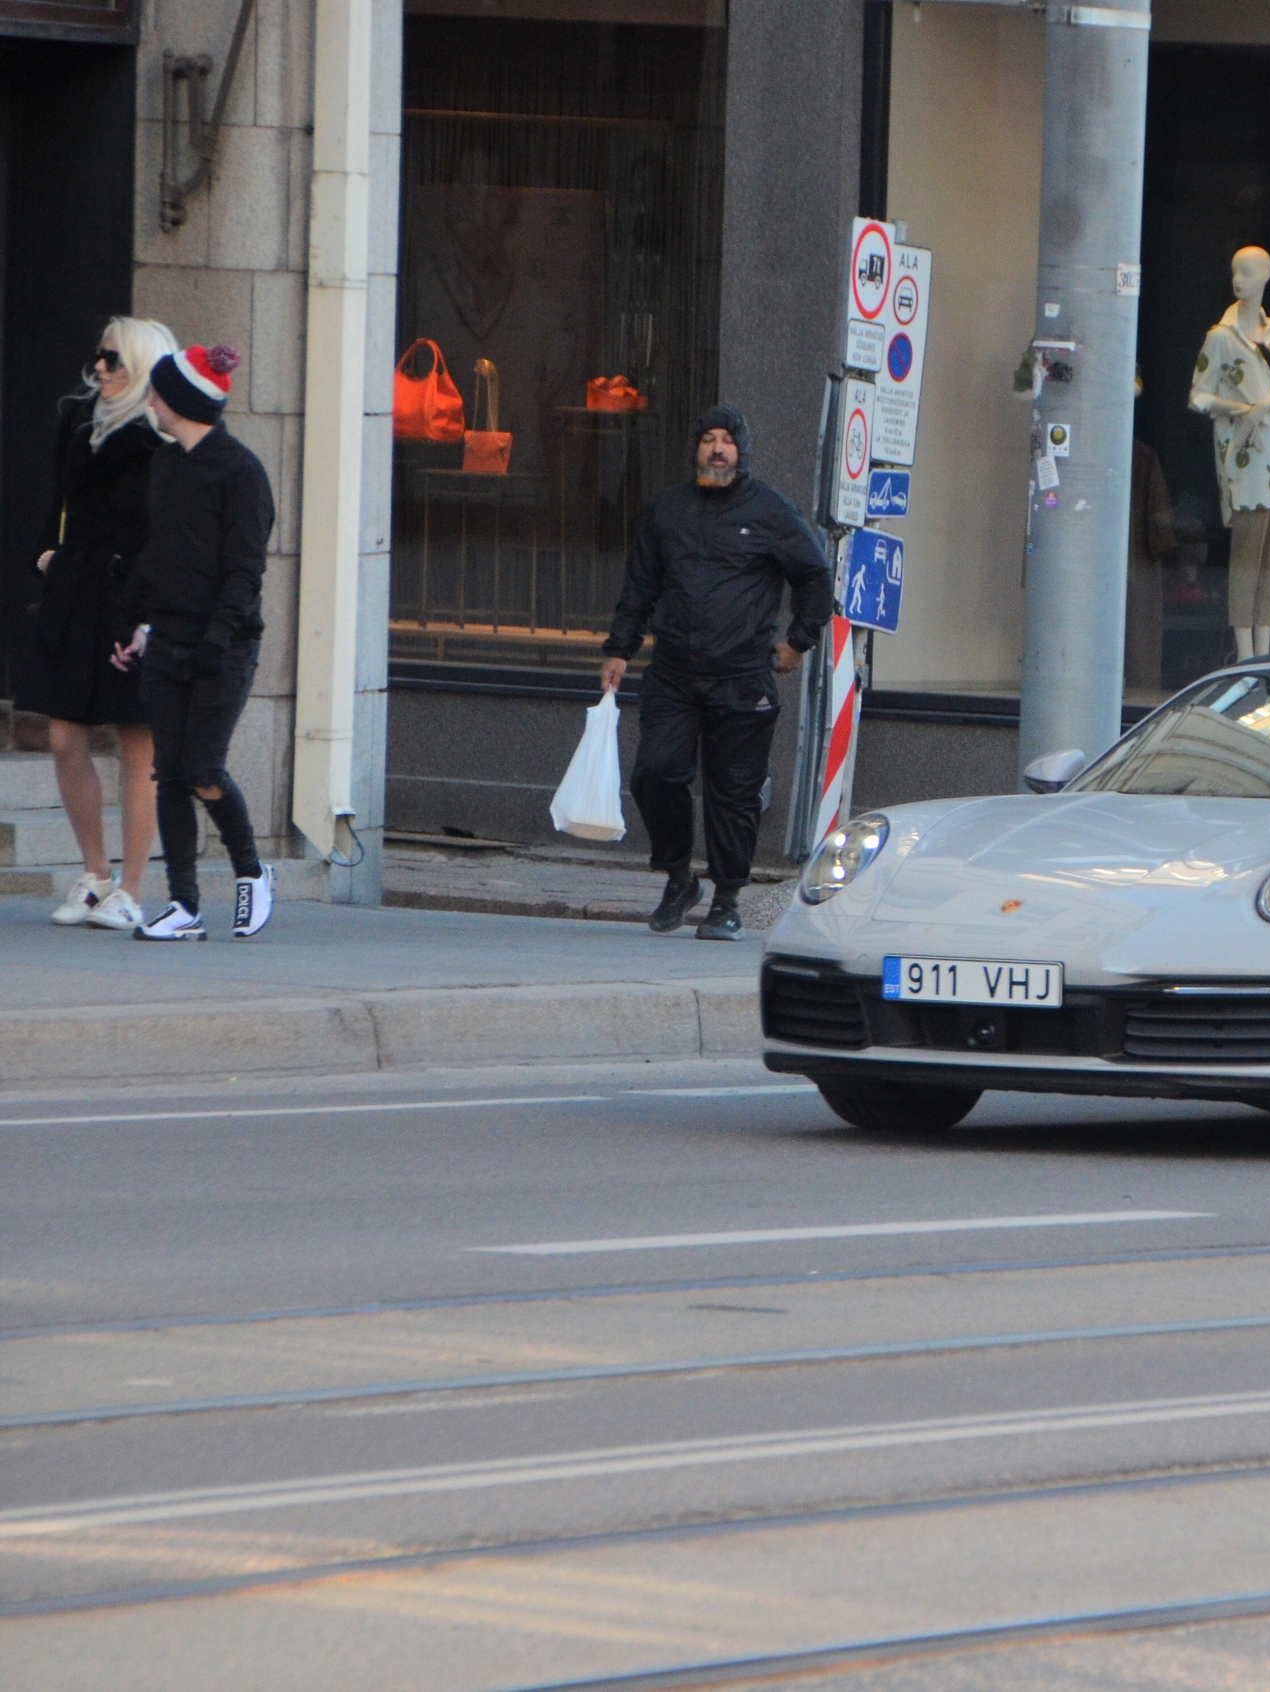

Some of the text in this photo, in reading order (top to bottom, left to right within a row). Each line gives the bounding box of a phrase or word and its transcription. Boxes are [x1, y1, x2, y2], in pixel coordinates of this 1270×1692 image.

[899, 252, 919, 270] ALA
[853, 386, 867, 403] ALA
[237, 885, 249, 919] DOLCE
[884, 984, 900, 994] EST
[908, 962, 1051, 1000] 911 VHJ
